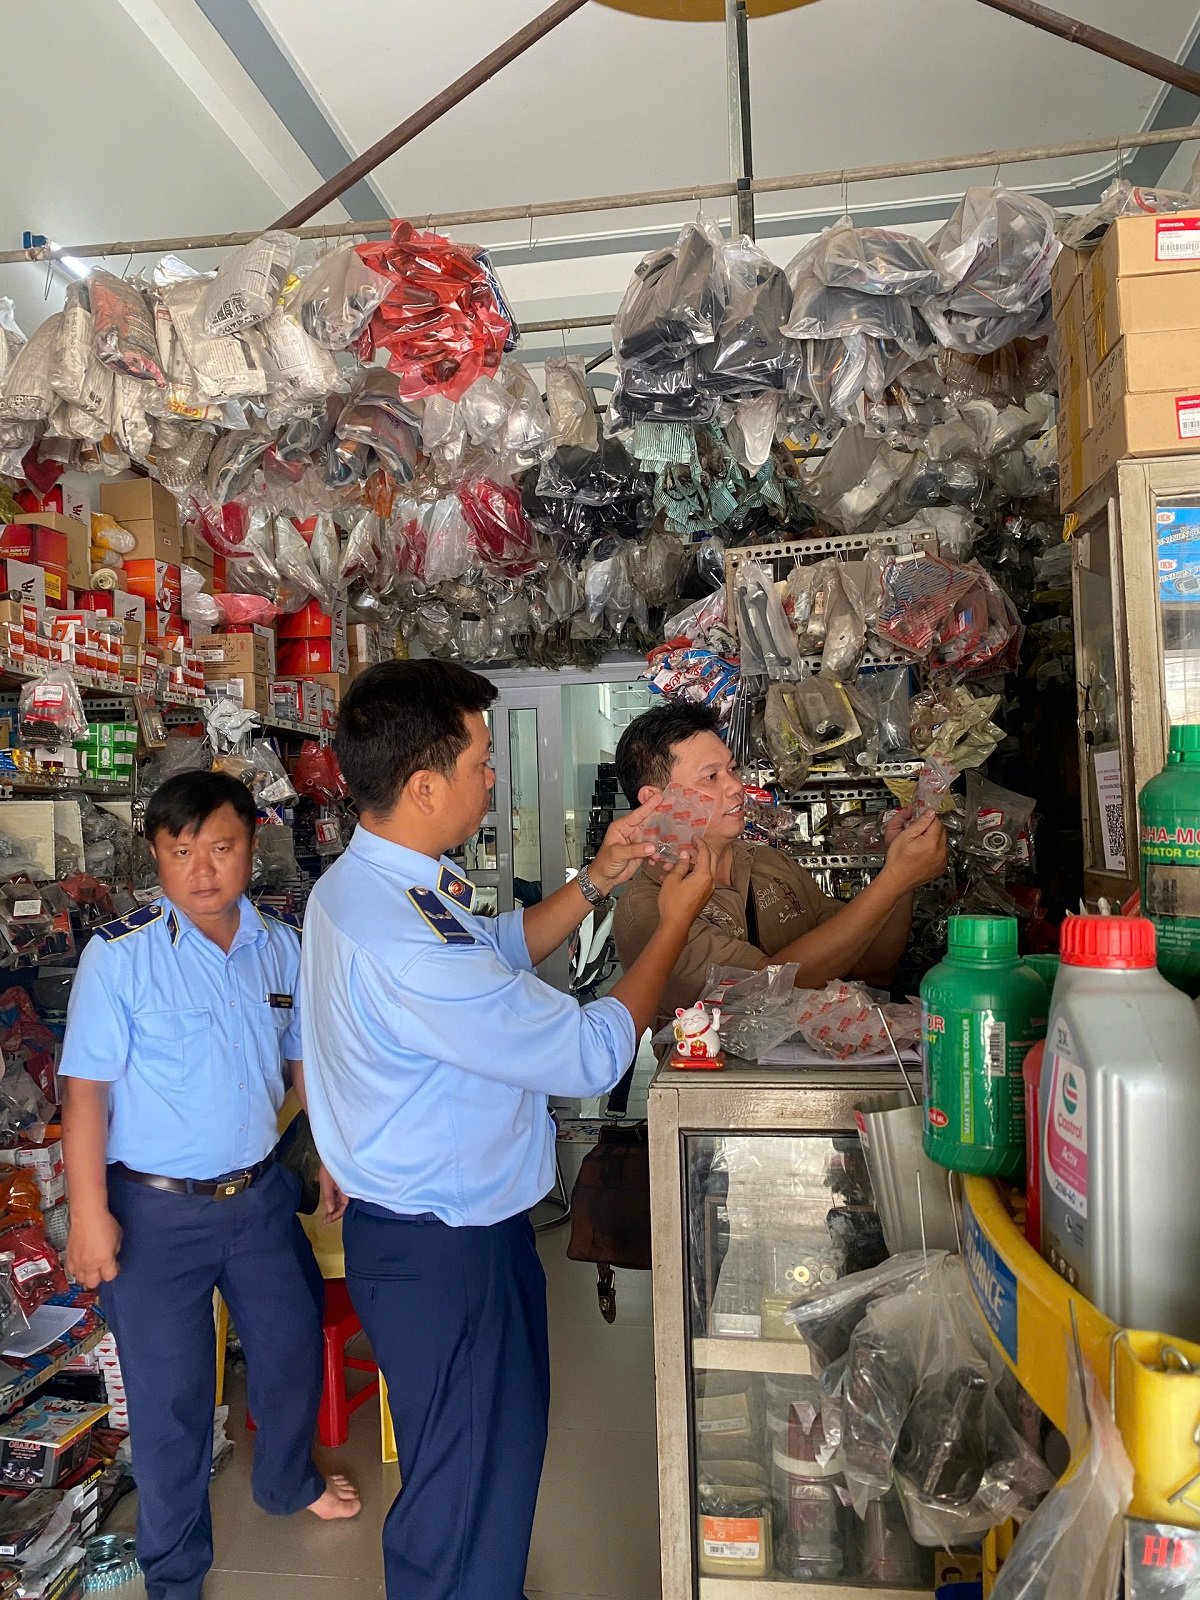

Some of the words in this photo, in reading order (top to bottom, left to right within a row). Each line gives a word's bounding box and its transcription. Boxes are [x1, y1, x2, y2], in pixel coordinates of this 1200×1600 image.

[962, 1019, 970, 1049] COOLER
[963, 1071, 971, 1105] ENGINES
[963, 1107, 971, 1134] MAKES
[1057, 1112, 1083, 1141] Castrol
